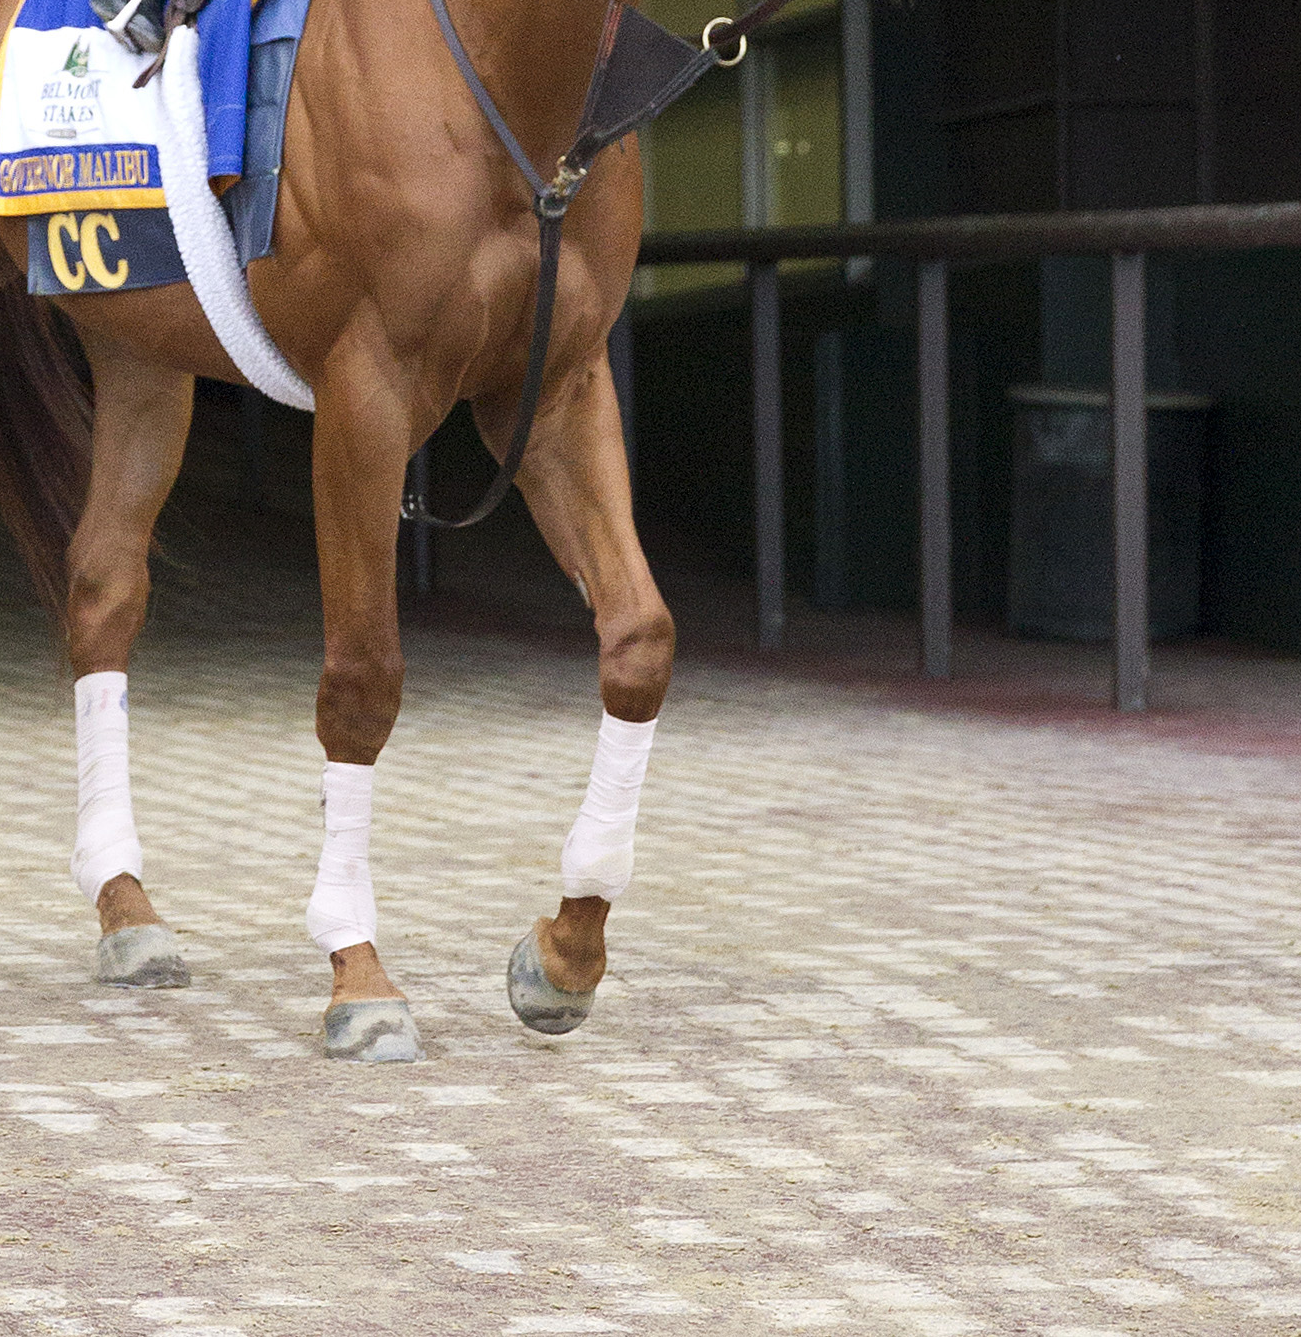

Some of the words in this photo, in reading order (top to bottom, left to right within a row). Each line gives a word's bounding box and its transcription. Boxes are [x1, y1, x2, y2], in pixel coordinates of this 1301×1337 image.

[41, 79, 101, 99] BELMONT
[43, 105, 94, 122] STAKES
[0, 153, 75, 193] GOVERNOR
[78, 150, 149, 187] MALIBU
[48, 213, 129, 290] CC
